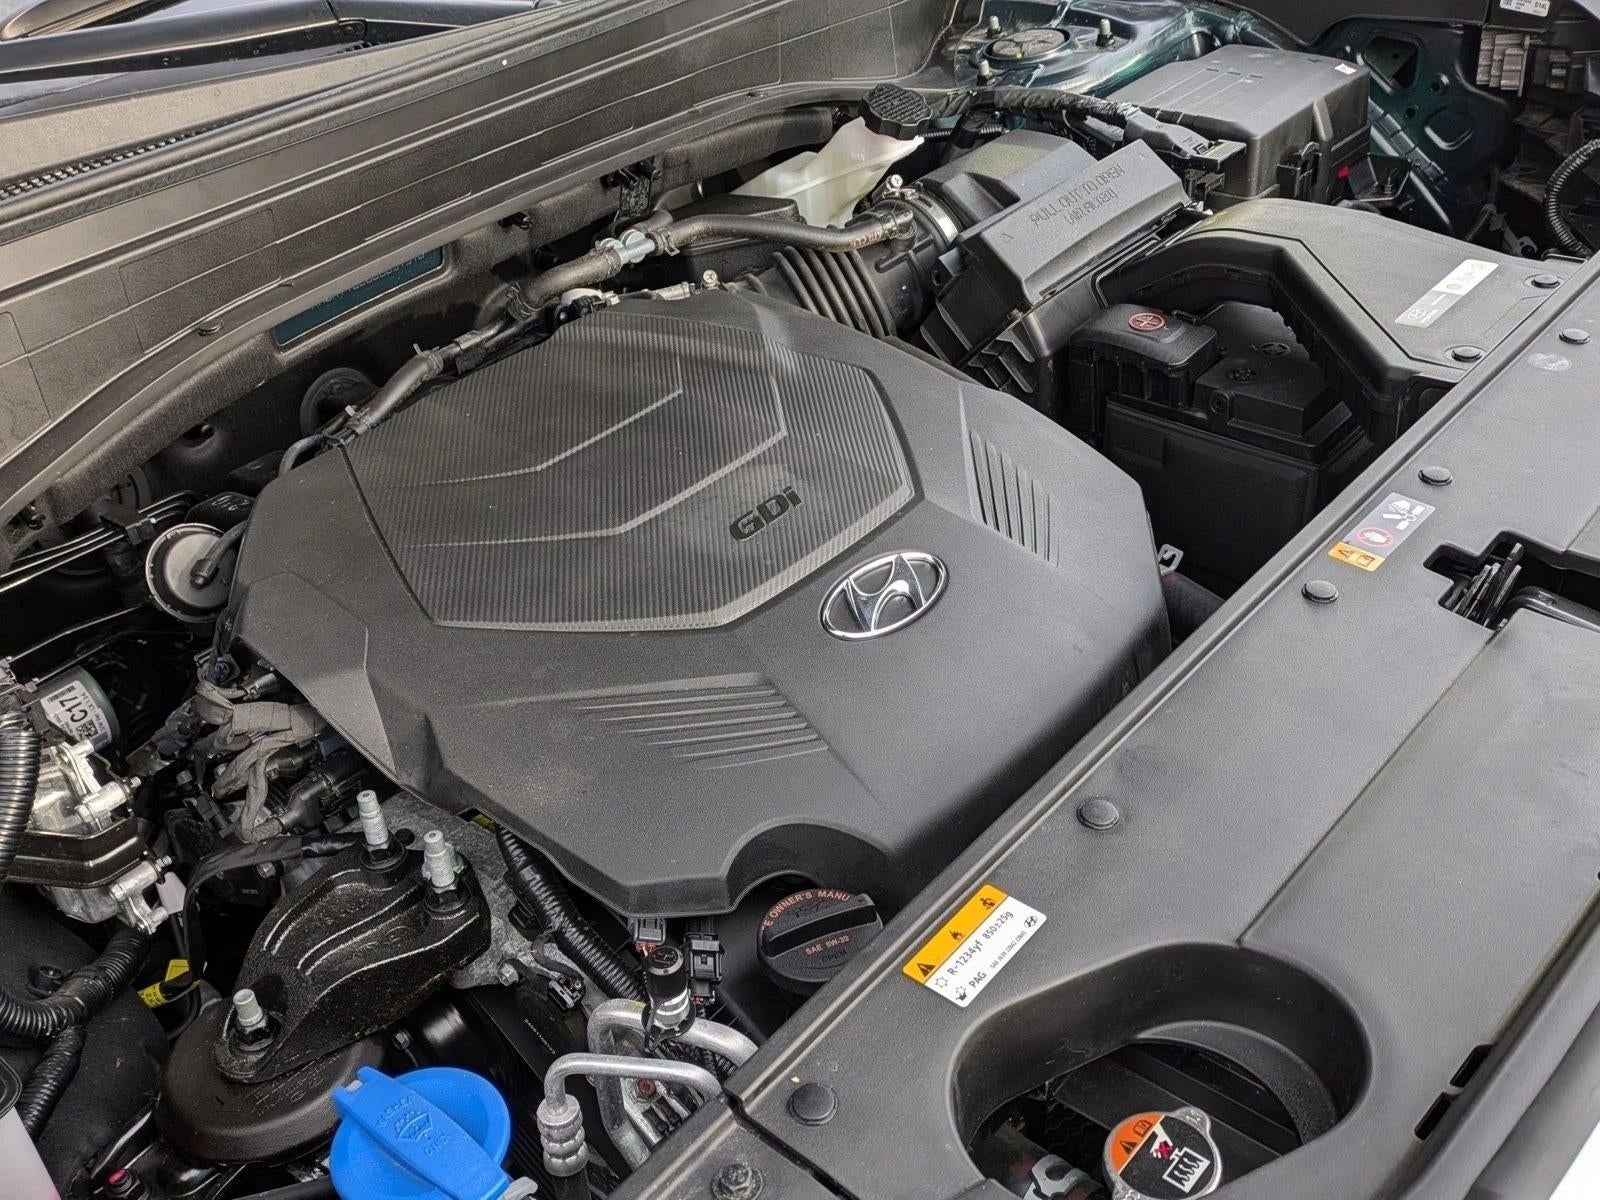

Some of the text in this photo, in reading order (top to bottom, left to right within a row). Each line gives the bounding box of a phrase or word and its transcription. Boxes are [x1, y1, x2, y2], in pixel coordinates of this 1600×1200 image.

[1028, 164, 1126, 227] PULL OUT TO OPEN
[729, 485, 802, 542] GDi
[60, 696, 88, 722] C17
[769, 891, 813, 918] OWNER'S
[817, 890, 851, 902] MANU
[805, 942, 824, 955] SAE
[947, 910, 1014, 976] R-1234yf 850±25g
[968, 970, 987, 988] PAG
